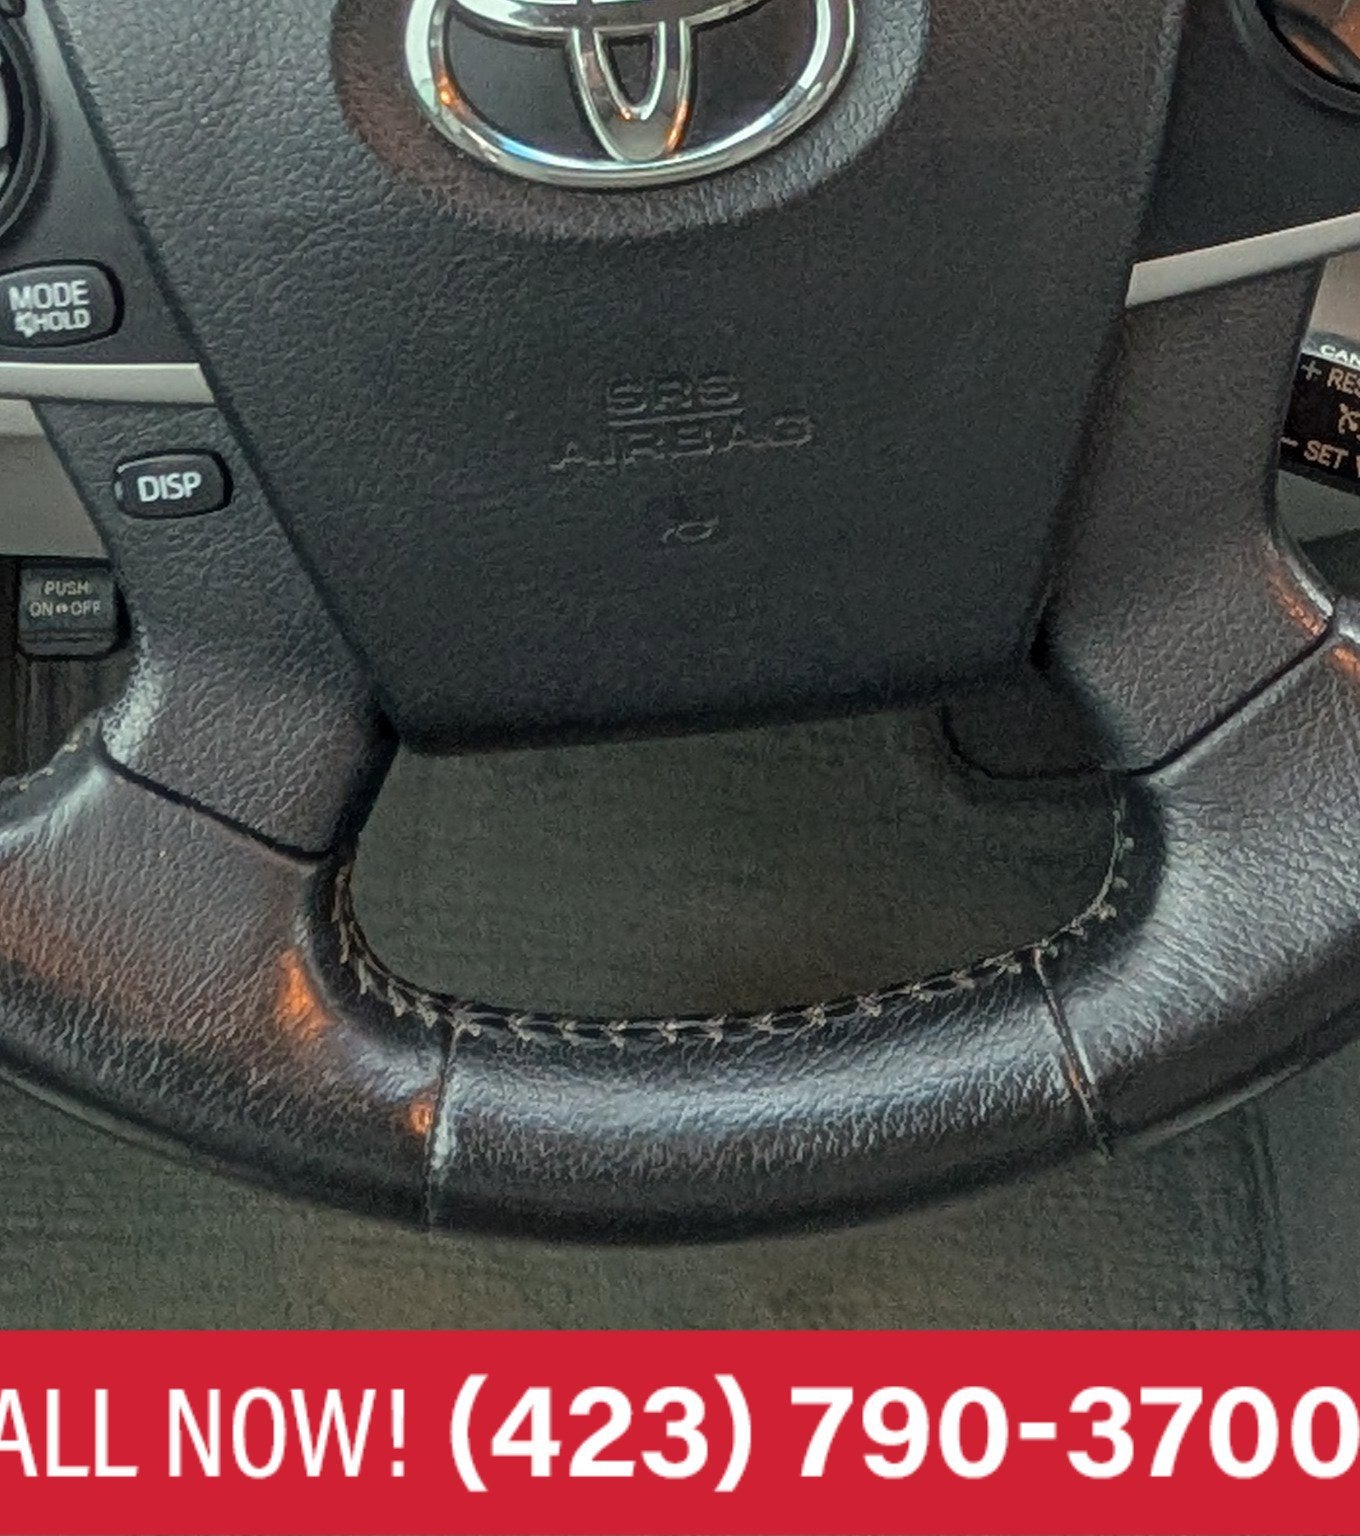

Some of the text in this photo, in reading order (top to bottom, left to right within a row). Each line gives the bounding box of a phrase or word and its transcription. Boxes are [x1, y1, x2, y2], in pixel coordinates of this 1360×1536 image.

[8, 279, 90, 311] MODE
[38, 308, 92, 333] HOLD
[1303, 439, 1349, 470] SET
[137, 471, 202, 503] DISP
[43, 580, 90, 597] PUSH
[29, 600, 102, 617] ON OFF
